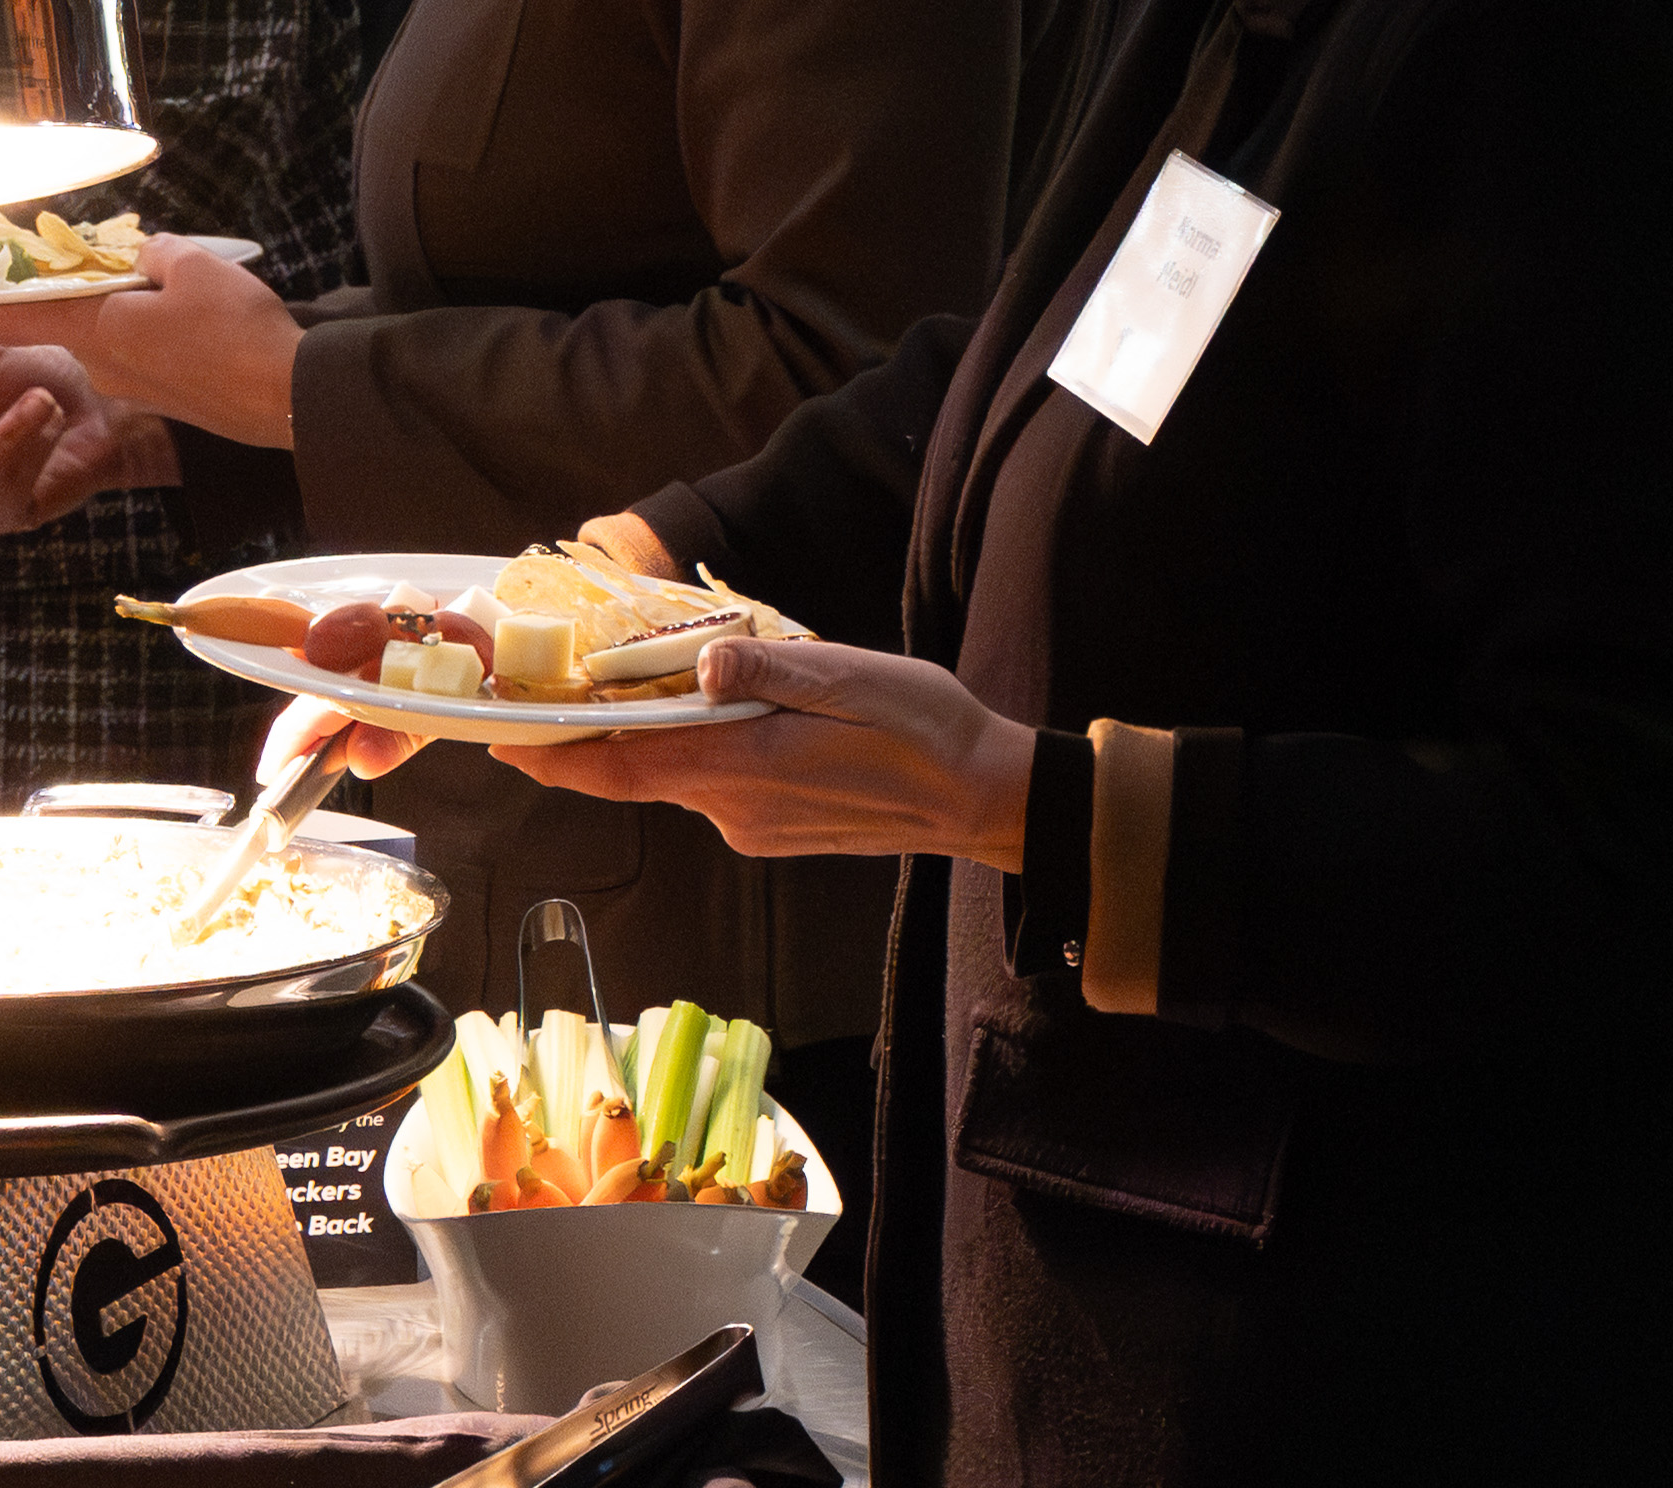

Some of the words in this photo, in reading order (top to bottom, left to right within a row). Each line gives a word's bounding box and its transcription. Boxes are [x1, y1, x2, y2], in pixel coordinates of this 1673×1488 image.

[355, 1114, 385, 1128] the
[275, 1152, 320, 1169] een
[325, 1145, 377, 1172] Bay
[286, 1179, 362, 1203] ckers
[308, 1211, 375, 1236] Back
